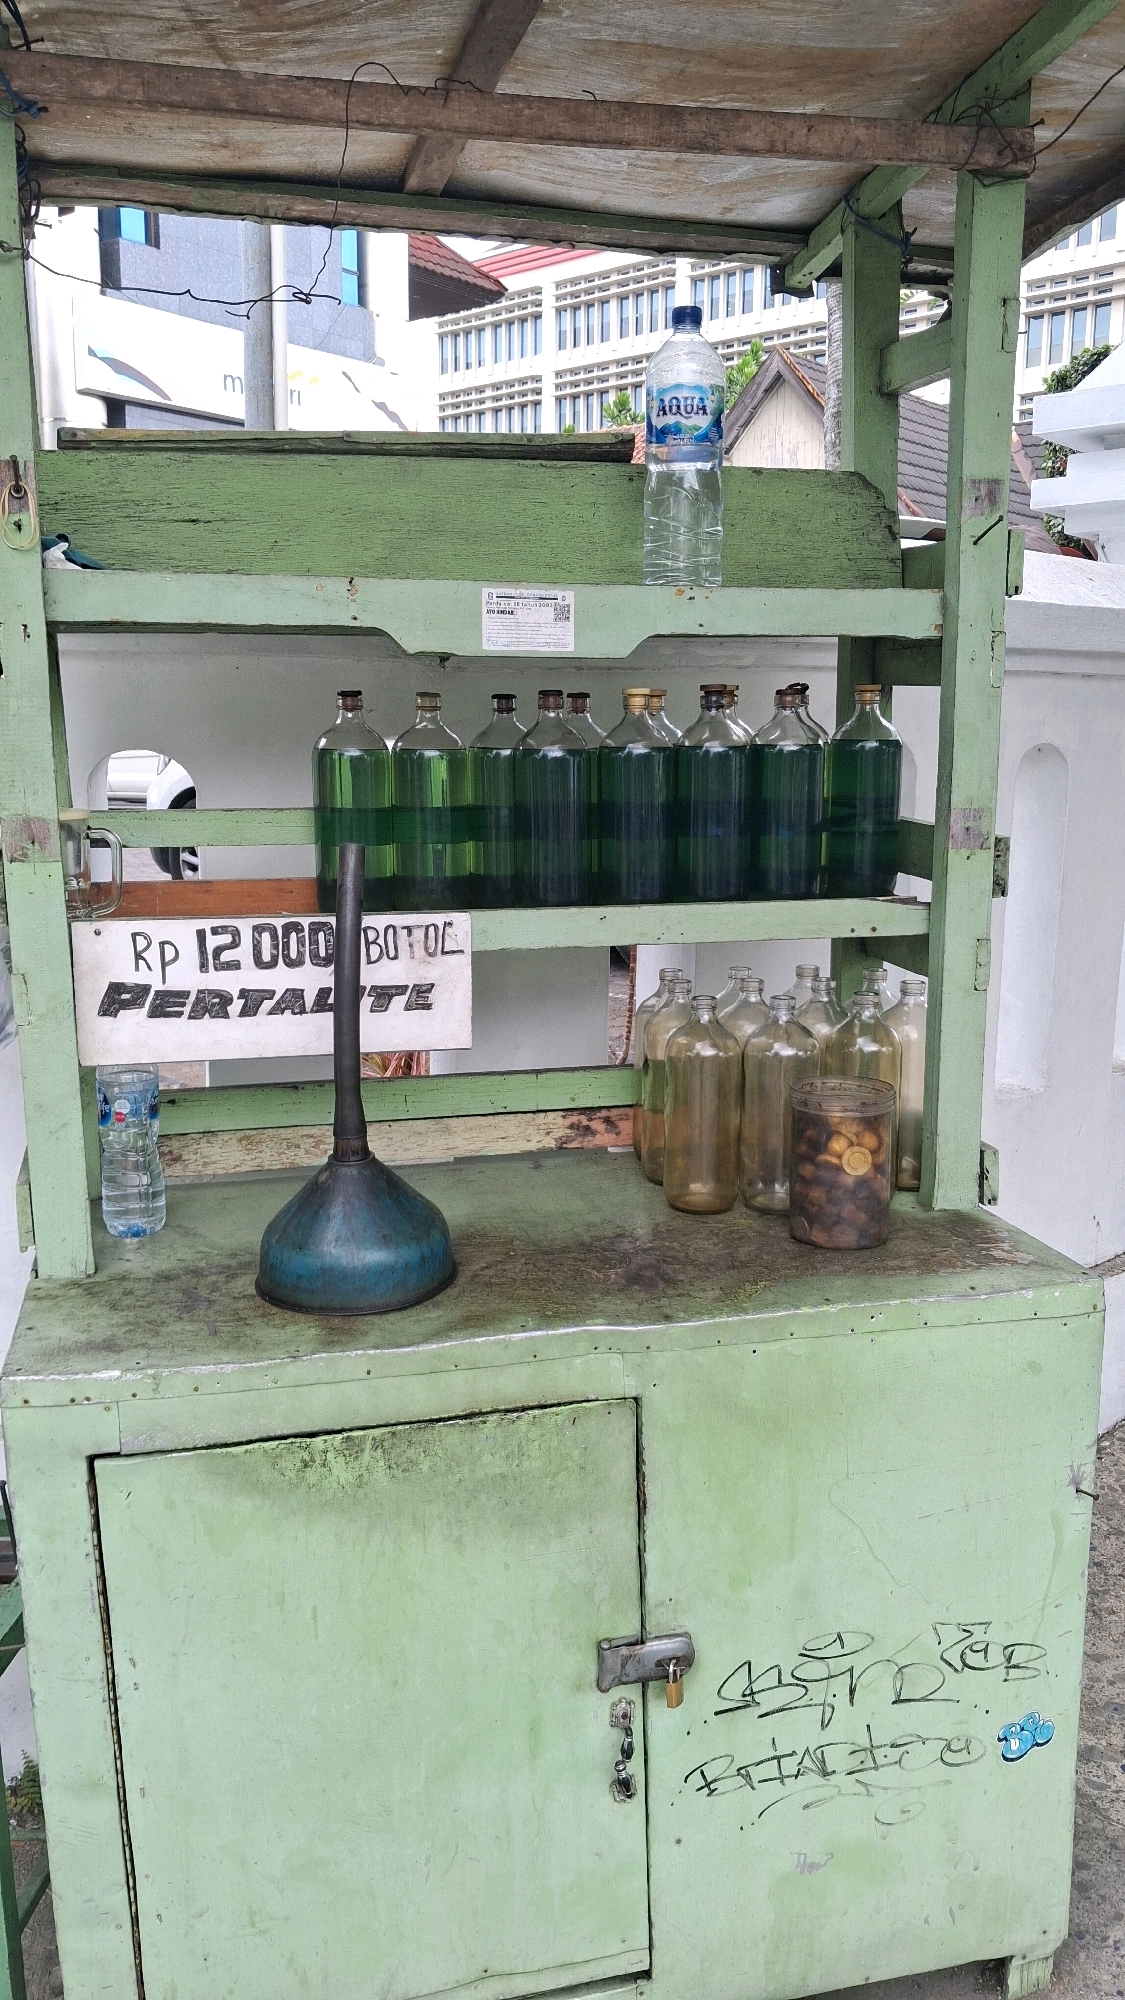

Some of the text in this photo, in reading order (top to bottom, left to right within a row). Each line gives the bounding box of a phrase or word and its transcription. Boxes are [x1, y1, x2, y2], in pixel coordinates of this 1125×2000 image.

[656, 395, 709, 420] AQUA
[131, 931, 180, 985] Rp
[97, 980, 436, 1021] PERTALTE
